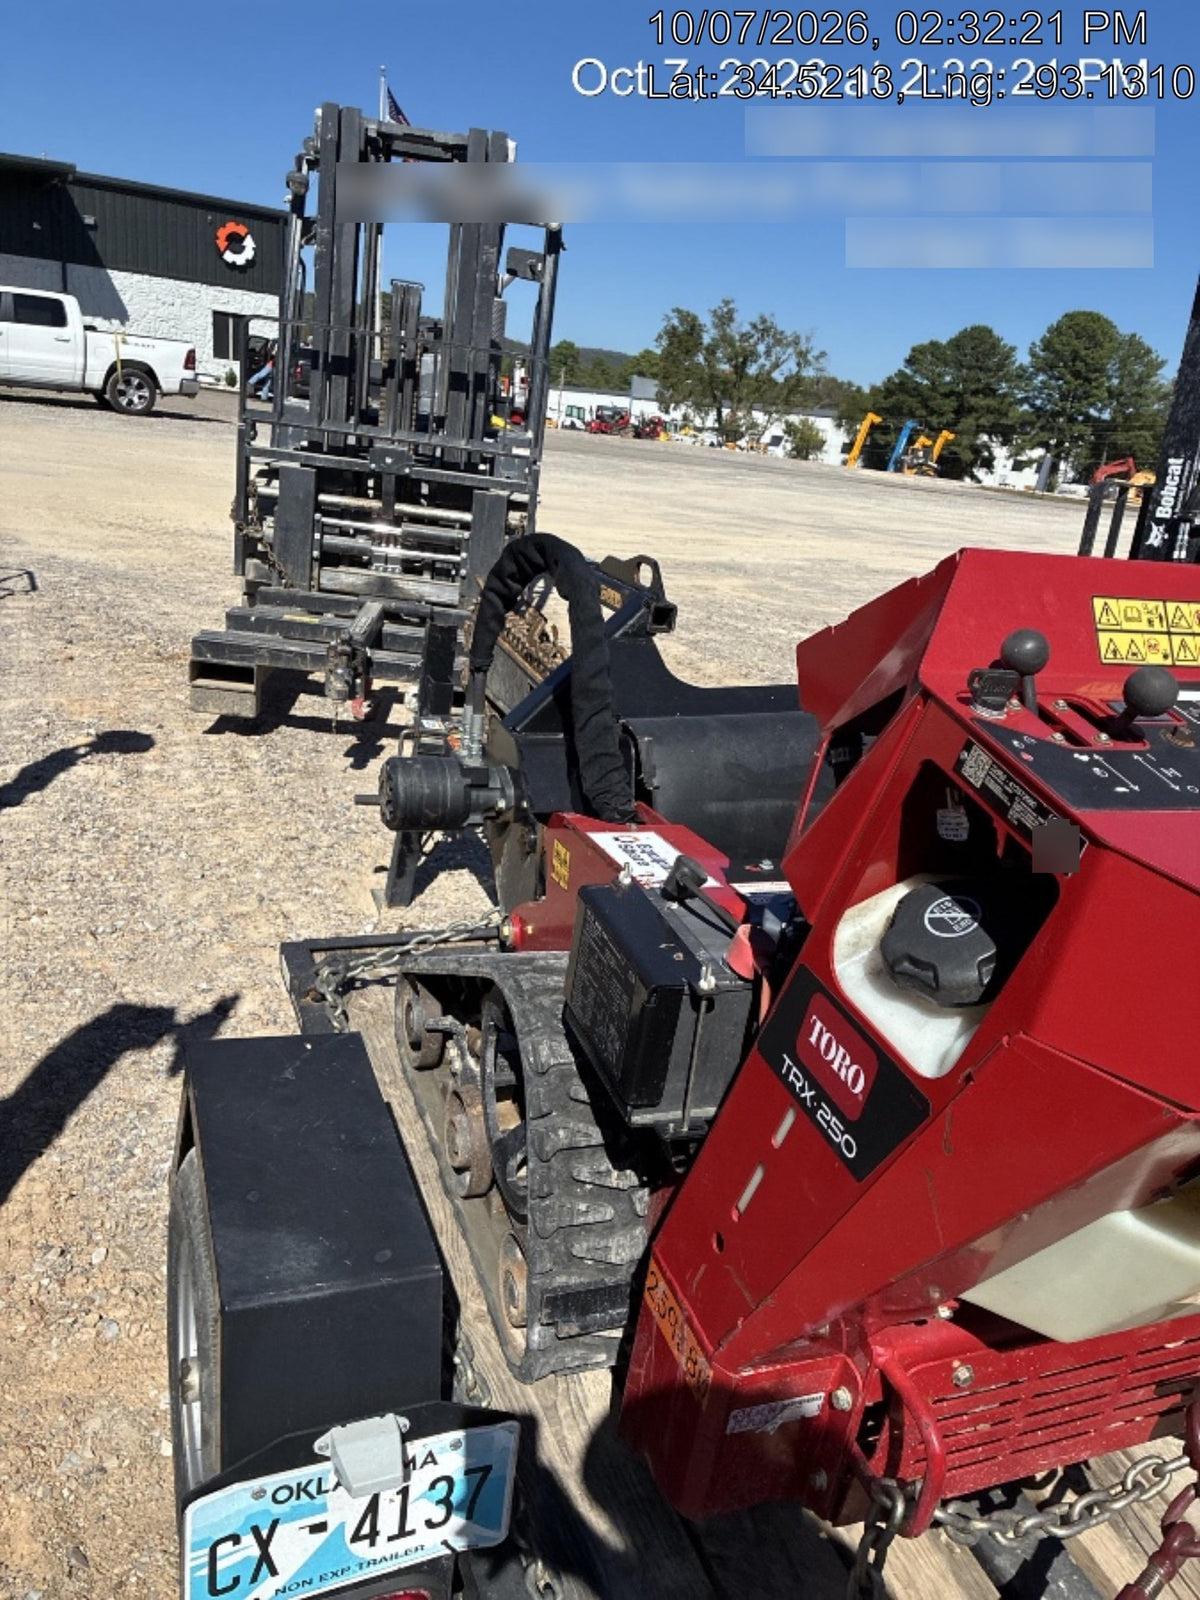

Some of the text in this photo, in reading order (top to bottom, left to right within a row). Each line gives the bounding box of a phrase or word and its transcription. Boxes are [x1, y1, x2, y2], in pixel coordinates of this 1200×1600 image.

[1155, 457, 1185, 519] Bobcat
[808, 1014, 866, 1095] TORO
[271, 1449, 438, 1505] OKLMA
[350, 1464, 493, 1548] 4137
